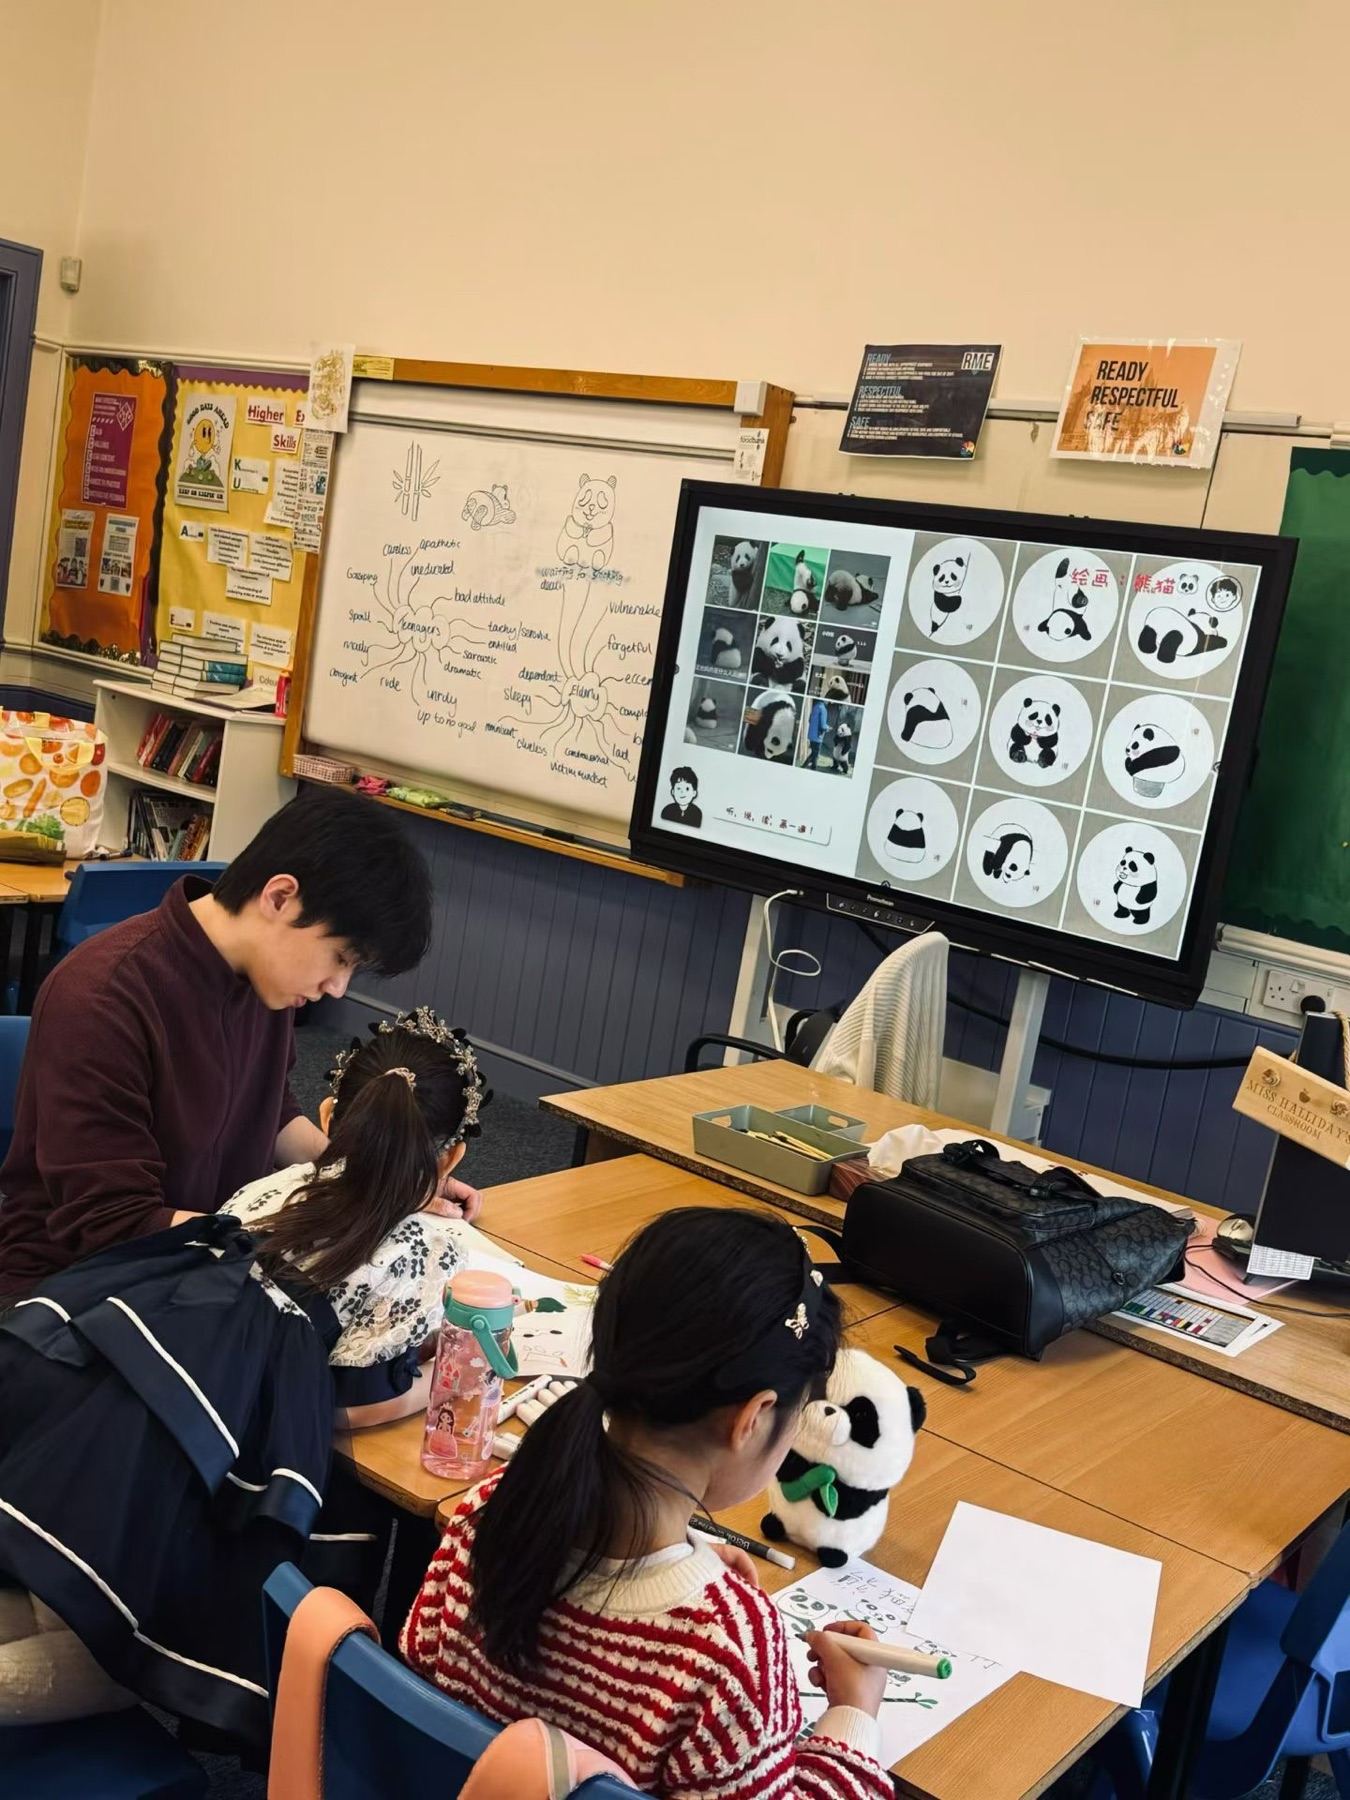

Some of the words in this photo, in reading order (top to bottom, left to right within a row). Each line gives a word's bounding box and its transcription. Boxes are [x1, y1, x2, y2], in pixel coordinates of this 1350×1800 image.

[867, 353, 892, 363] READY
[962, 353, 993, 370] RME
[1096, 360, 1149, 382] READY
[859, 386, 902, 396] RESPECTFUL
[1090, 386, 1179, 408] RESPECTFUL
[247, 405, 284, 422] Higher
[851, 416, 871, 427] SAFE
[273, 434, 297, 449] Skills
[455, 587, 472, 602] bad
[473, 592, 506, 606] attitude
[607, 634, 653, 660] forgetful
[462, 650, 498, 665] sarcastic
[444, 661, 482, 680] dramatic
[380, 677, 401, 691] rude
[427, 690, 458, 718] unruly
[569, 685, 600, 712] Elderly
[434, 712, 445, 725] to
[446, 718, 456, 727] no
[457, 721, 477, 738] good
[1246, 1080, 1278, 1102] MISS
[1267, 1104, 1323, 1140] CLASSROOM
